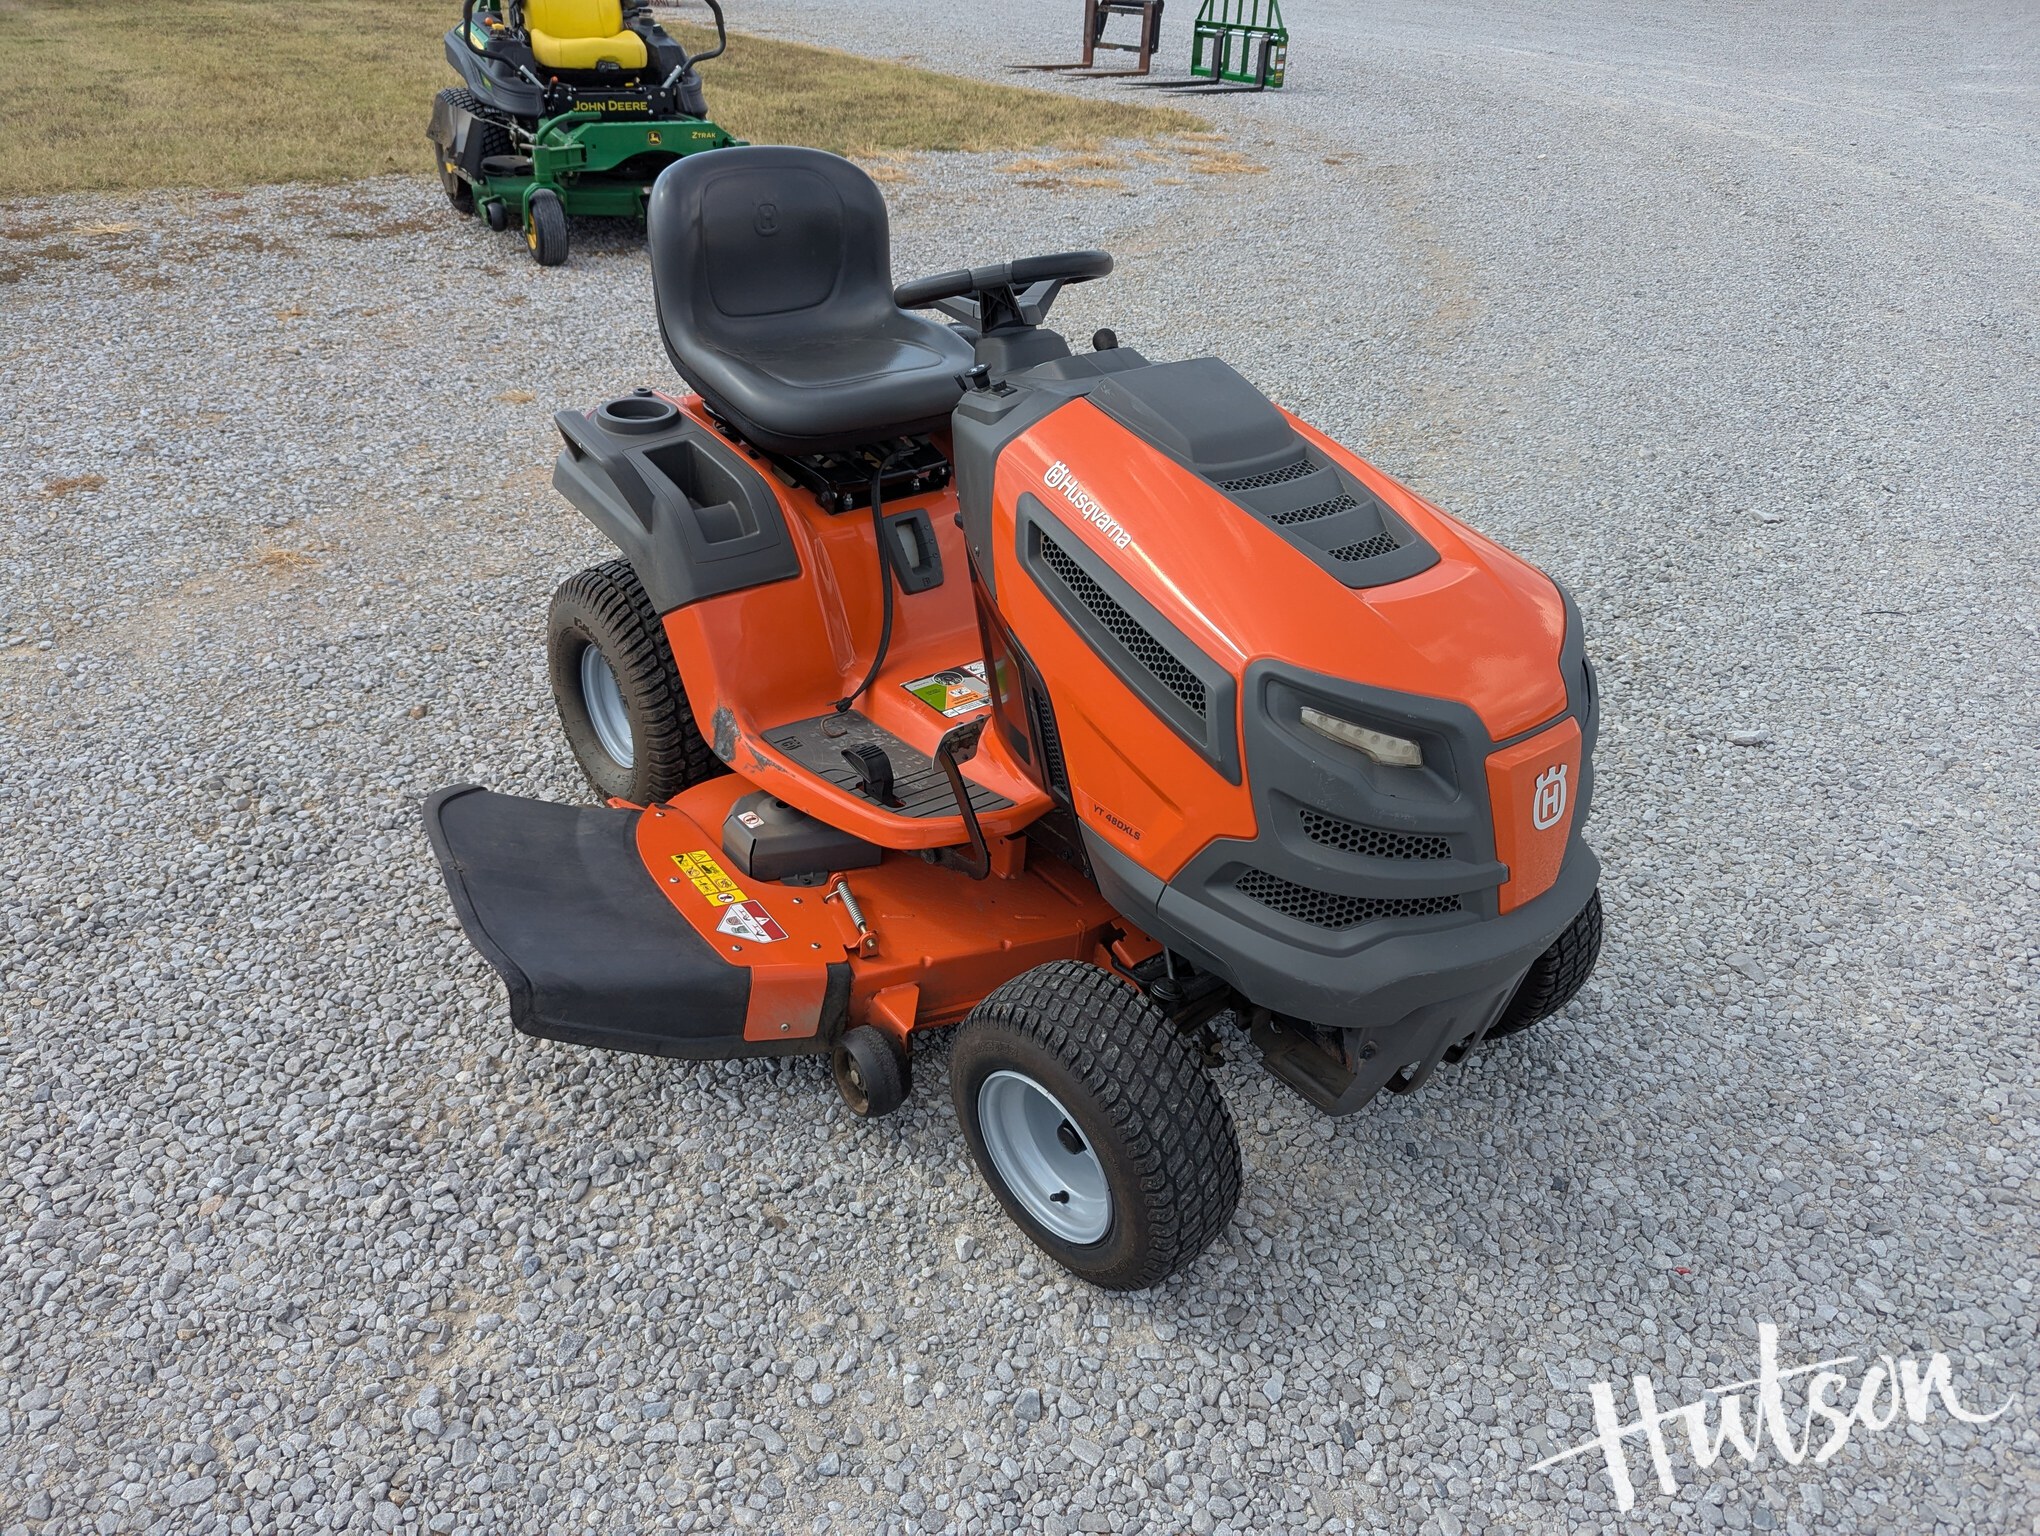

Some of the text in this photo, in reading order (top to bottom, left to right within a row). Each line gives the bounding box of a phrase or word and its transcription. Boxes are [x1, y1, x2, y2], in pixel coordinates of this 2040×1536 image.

[573, 100, 648, 112] JOHN DEERE
[691, 131, 716, 139] ZTRAK
[1057, 474, 1133, 550] Husqvarna
[1094, 805, 1104, 816] YT
